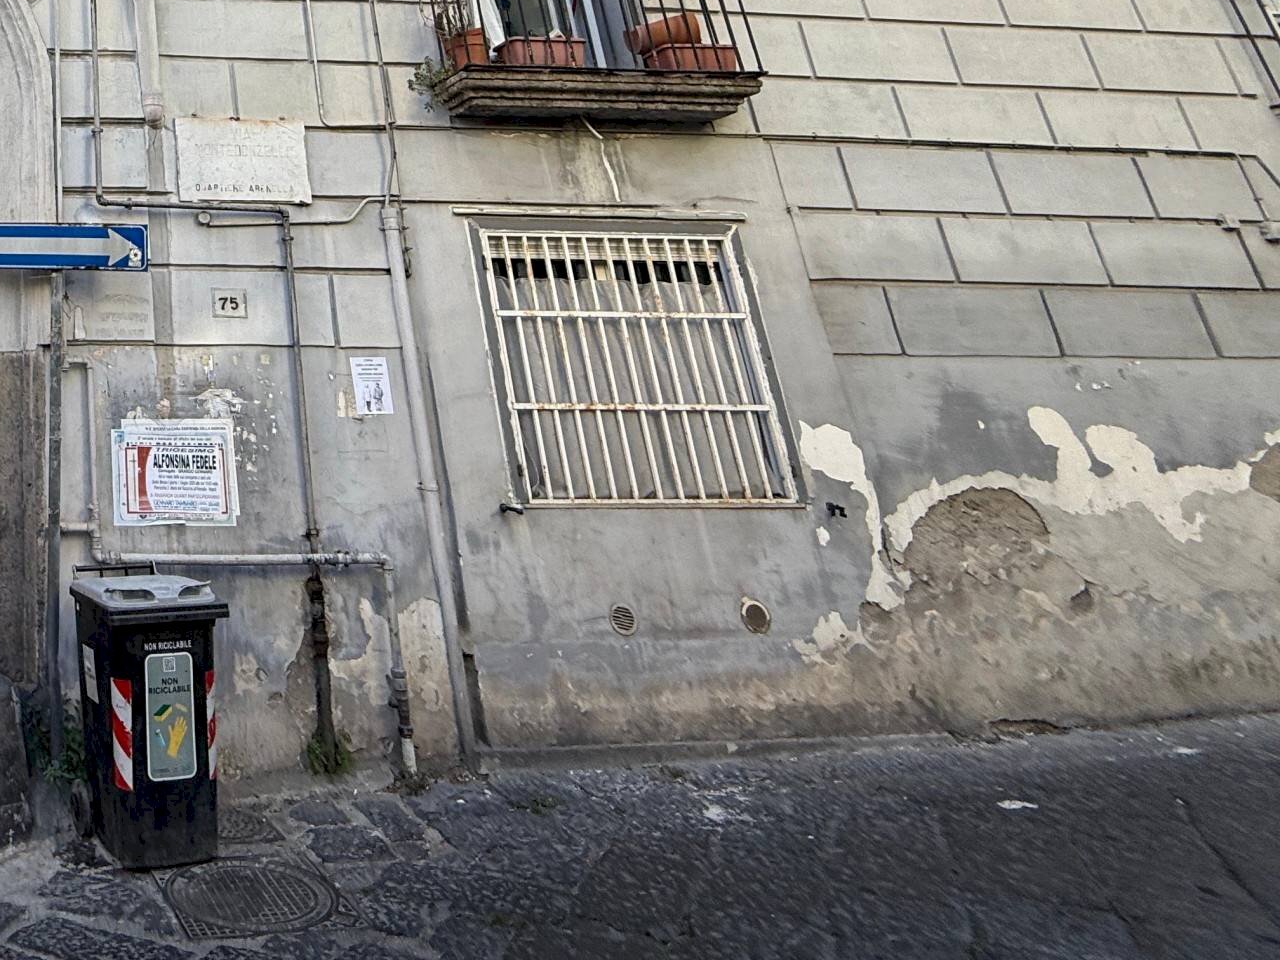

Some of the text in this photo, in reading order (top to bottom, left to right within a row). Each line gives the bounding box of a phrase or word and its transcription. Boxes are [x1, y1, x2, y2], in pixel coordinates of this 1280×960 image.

[218, 296, 239, 311] 75
[153, 453, 217, 470] ALFONSINA FEDELE
[143, 642, 157, 651] NON
[161, 677, 179, 686] NON
